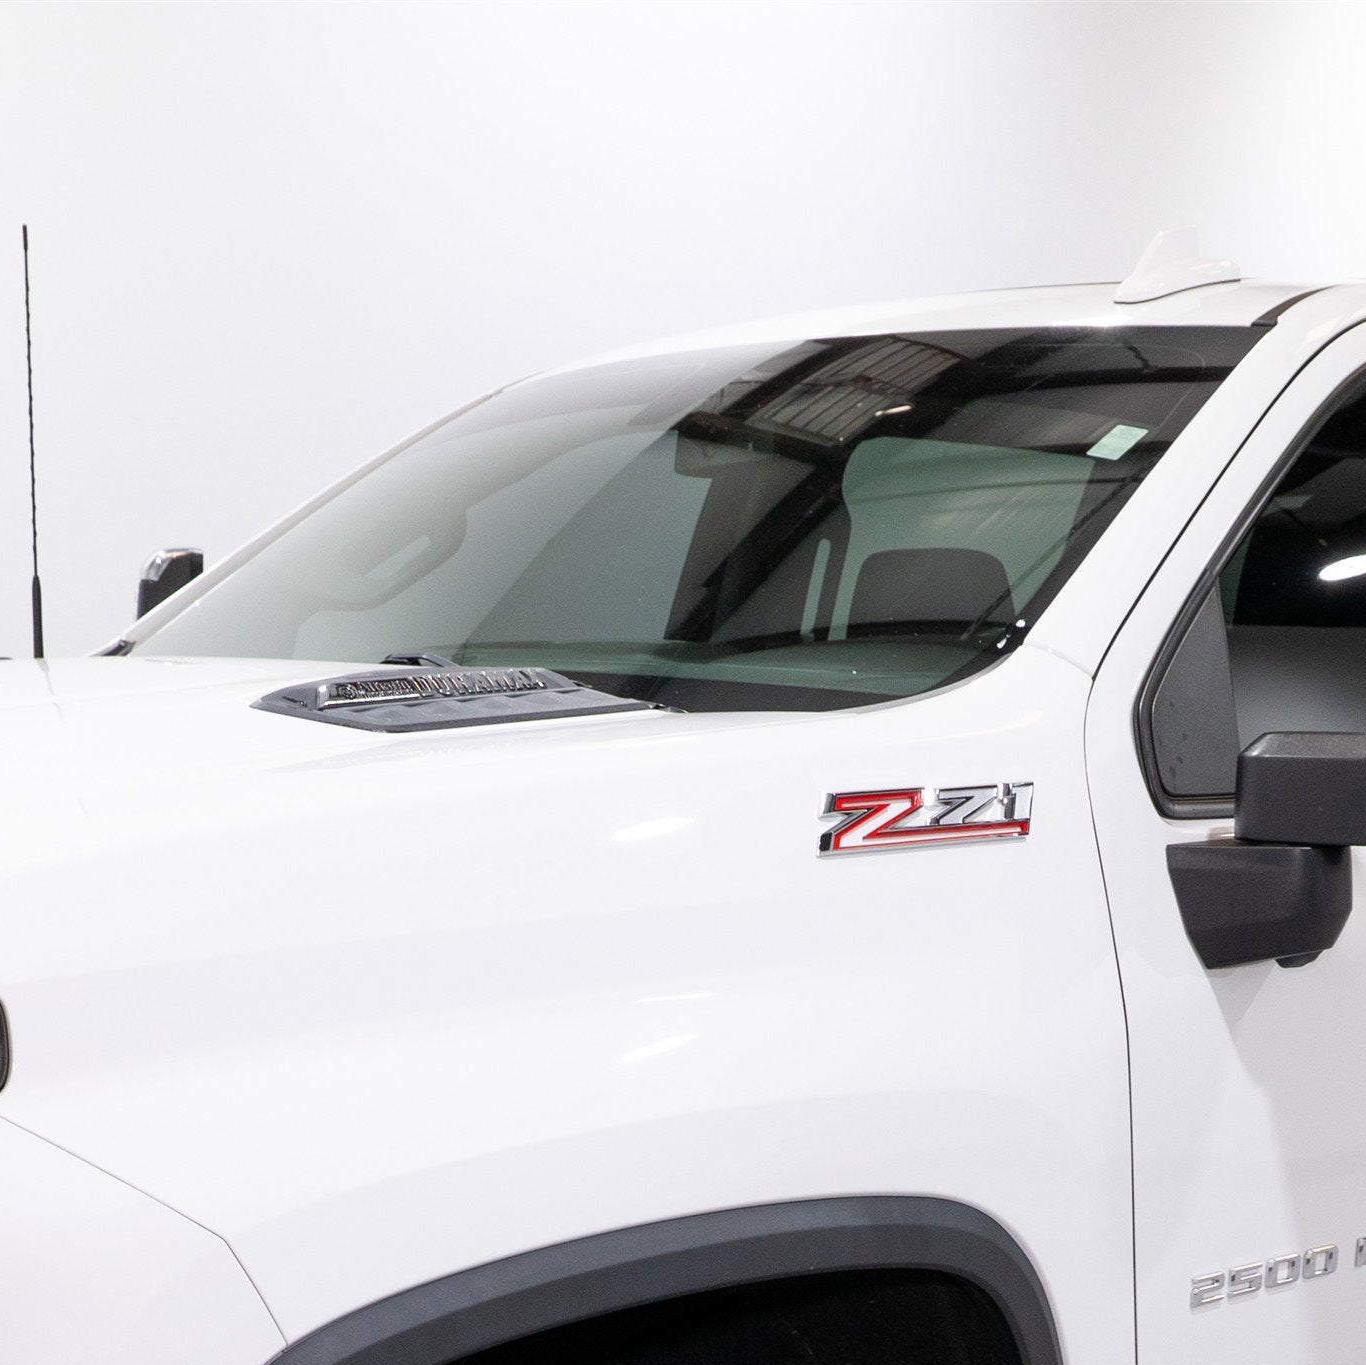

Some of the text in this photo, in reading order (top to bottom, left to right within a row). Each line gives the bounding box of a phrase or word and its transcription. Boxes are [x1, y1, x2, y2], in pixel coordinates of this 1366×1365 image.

[409, 669, 548, 698] DURAMAX
[816, 781, 1034, 858] Z71
[1190, 1242, 1338, 1312] 2500
